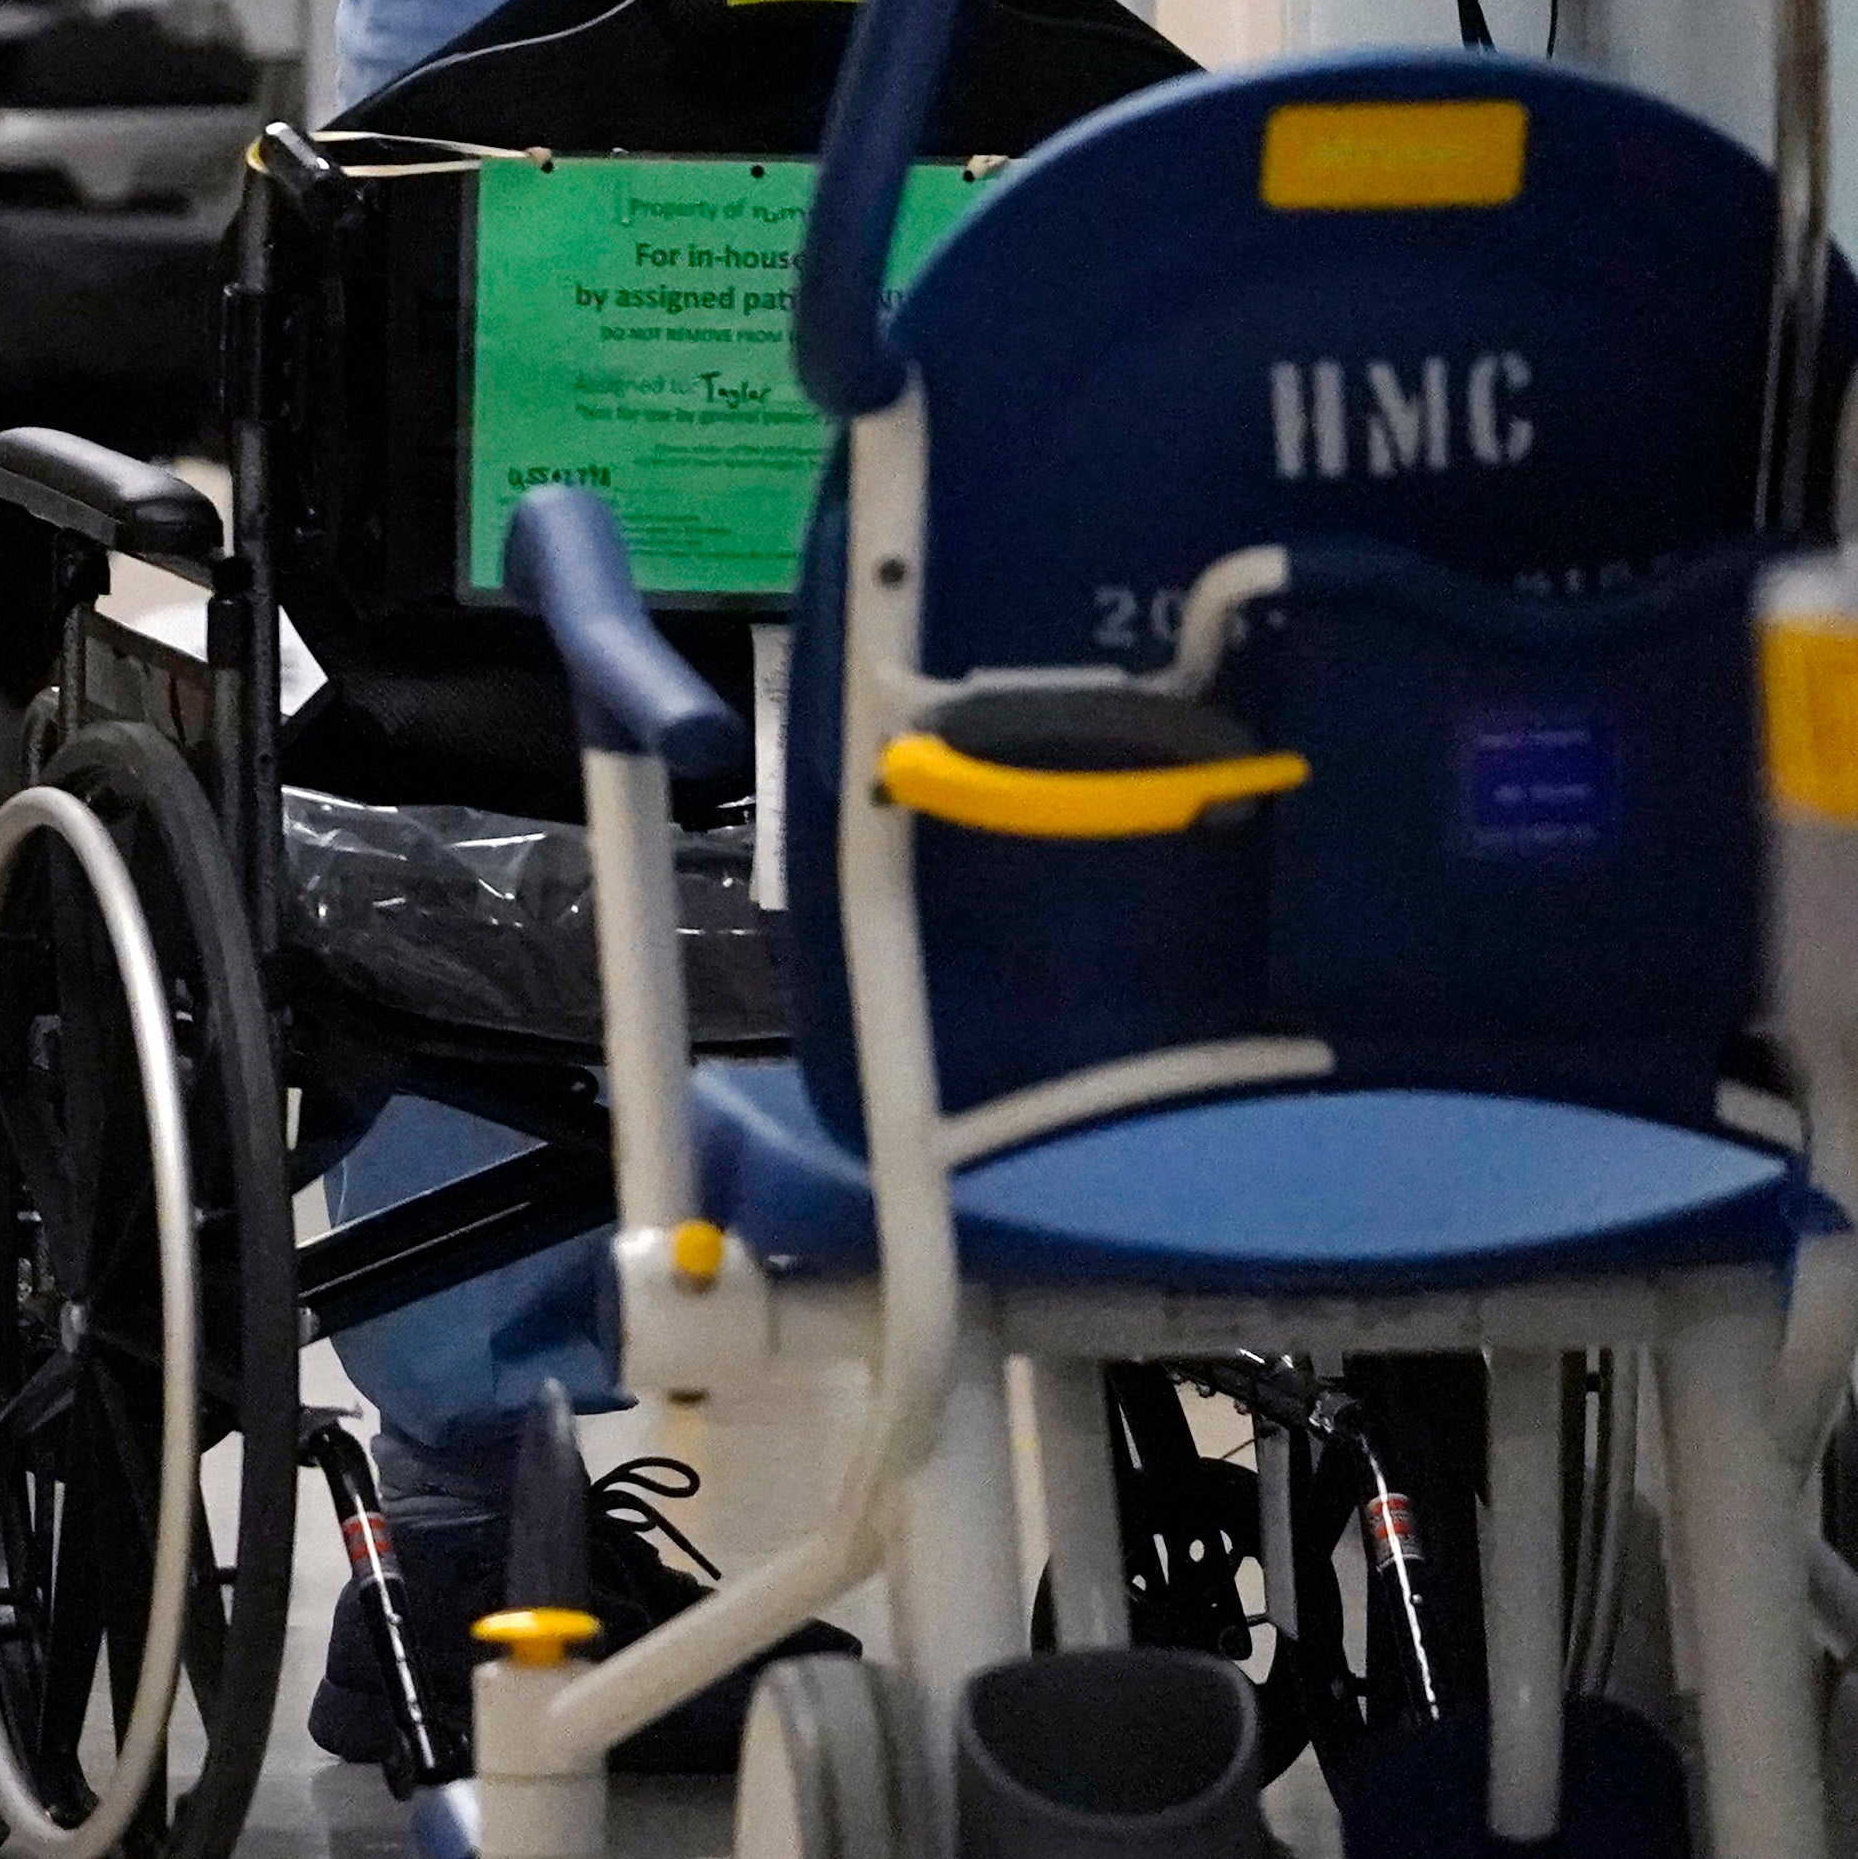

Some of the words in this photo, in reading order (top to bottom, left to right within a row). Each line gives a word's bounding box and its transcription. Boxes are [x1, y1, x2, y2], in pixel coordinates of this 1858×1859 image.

[635, 243, 686, 269] For
[575, 284, 609, 313] by
[614, 284, 736, 315] assigned
[1269, 348, 1536, 481] HMC
